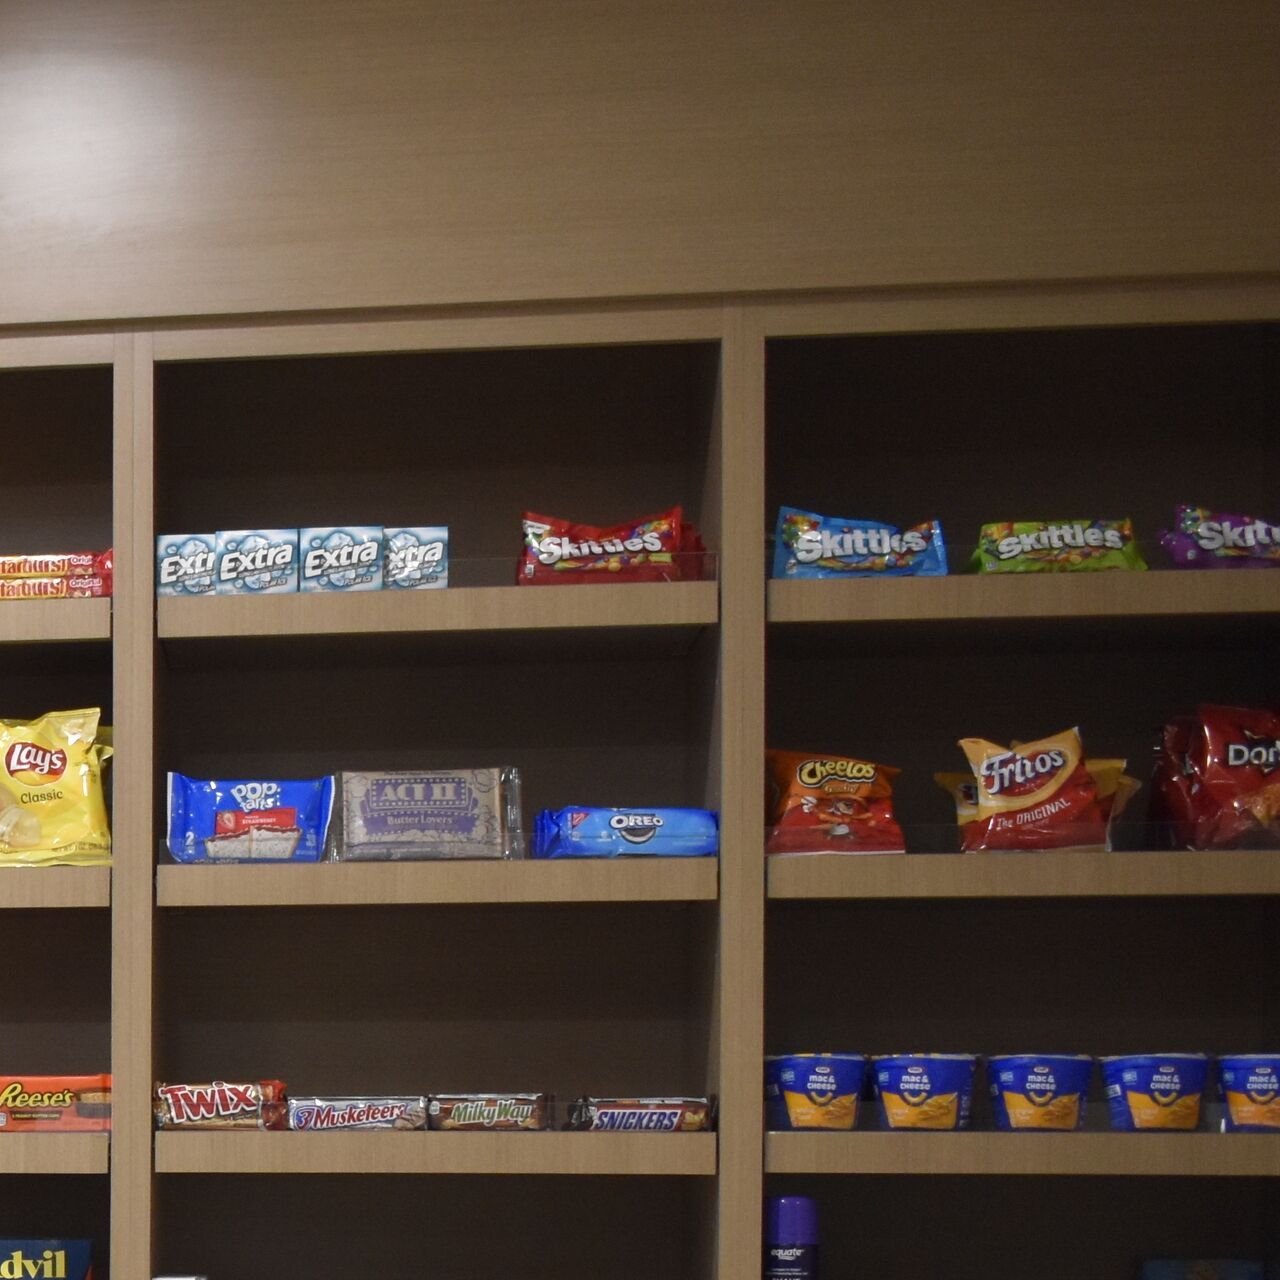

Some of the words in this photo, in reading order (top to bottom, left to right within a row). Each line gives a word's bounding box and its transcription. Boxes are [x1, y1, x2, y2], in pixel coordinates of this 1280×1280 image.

[539, 532, 662, 565] Skittles
[998, 524, 1122, 560] Skittles
[221, 544, 293, 580] Extra
[305, 541, 378, 579] Extra
[388, 541, 443, 571] xtra
[10, 744, 64, 774] Lay's
[798, 760, 877, 787] Cheetos
[20, 788, 64, 804] Classic
[380, 783, 426, 800] ACT
[430, 783, 457, 800] II
[387, 815, 419, 825] Butter
[420, 815, 453, 825] Lovers
[610, 814, 664, 829] OREO
[996, 816, 1013, 830] The
[1016, 797, 1071, 826] ORIGINAL
[294, 1106, 311, 1130] 3
[312, 1103, 409, 1130] Musketeers
[596, 1110, 681, 1130] SNICKERS
[770, 1247, 802, 1258] equate
